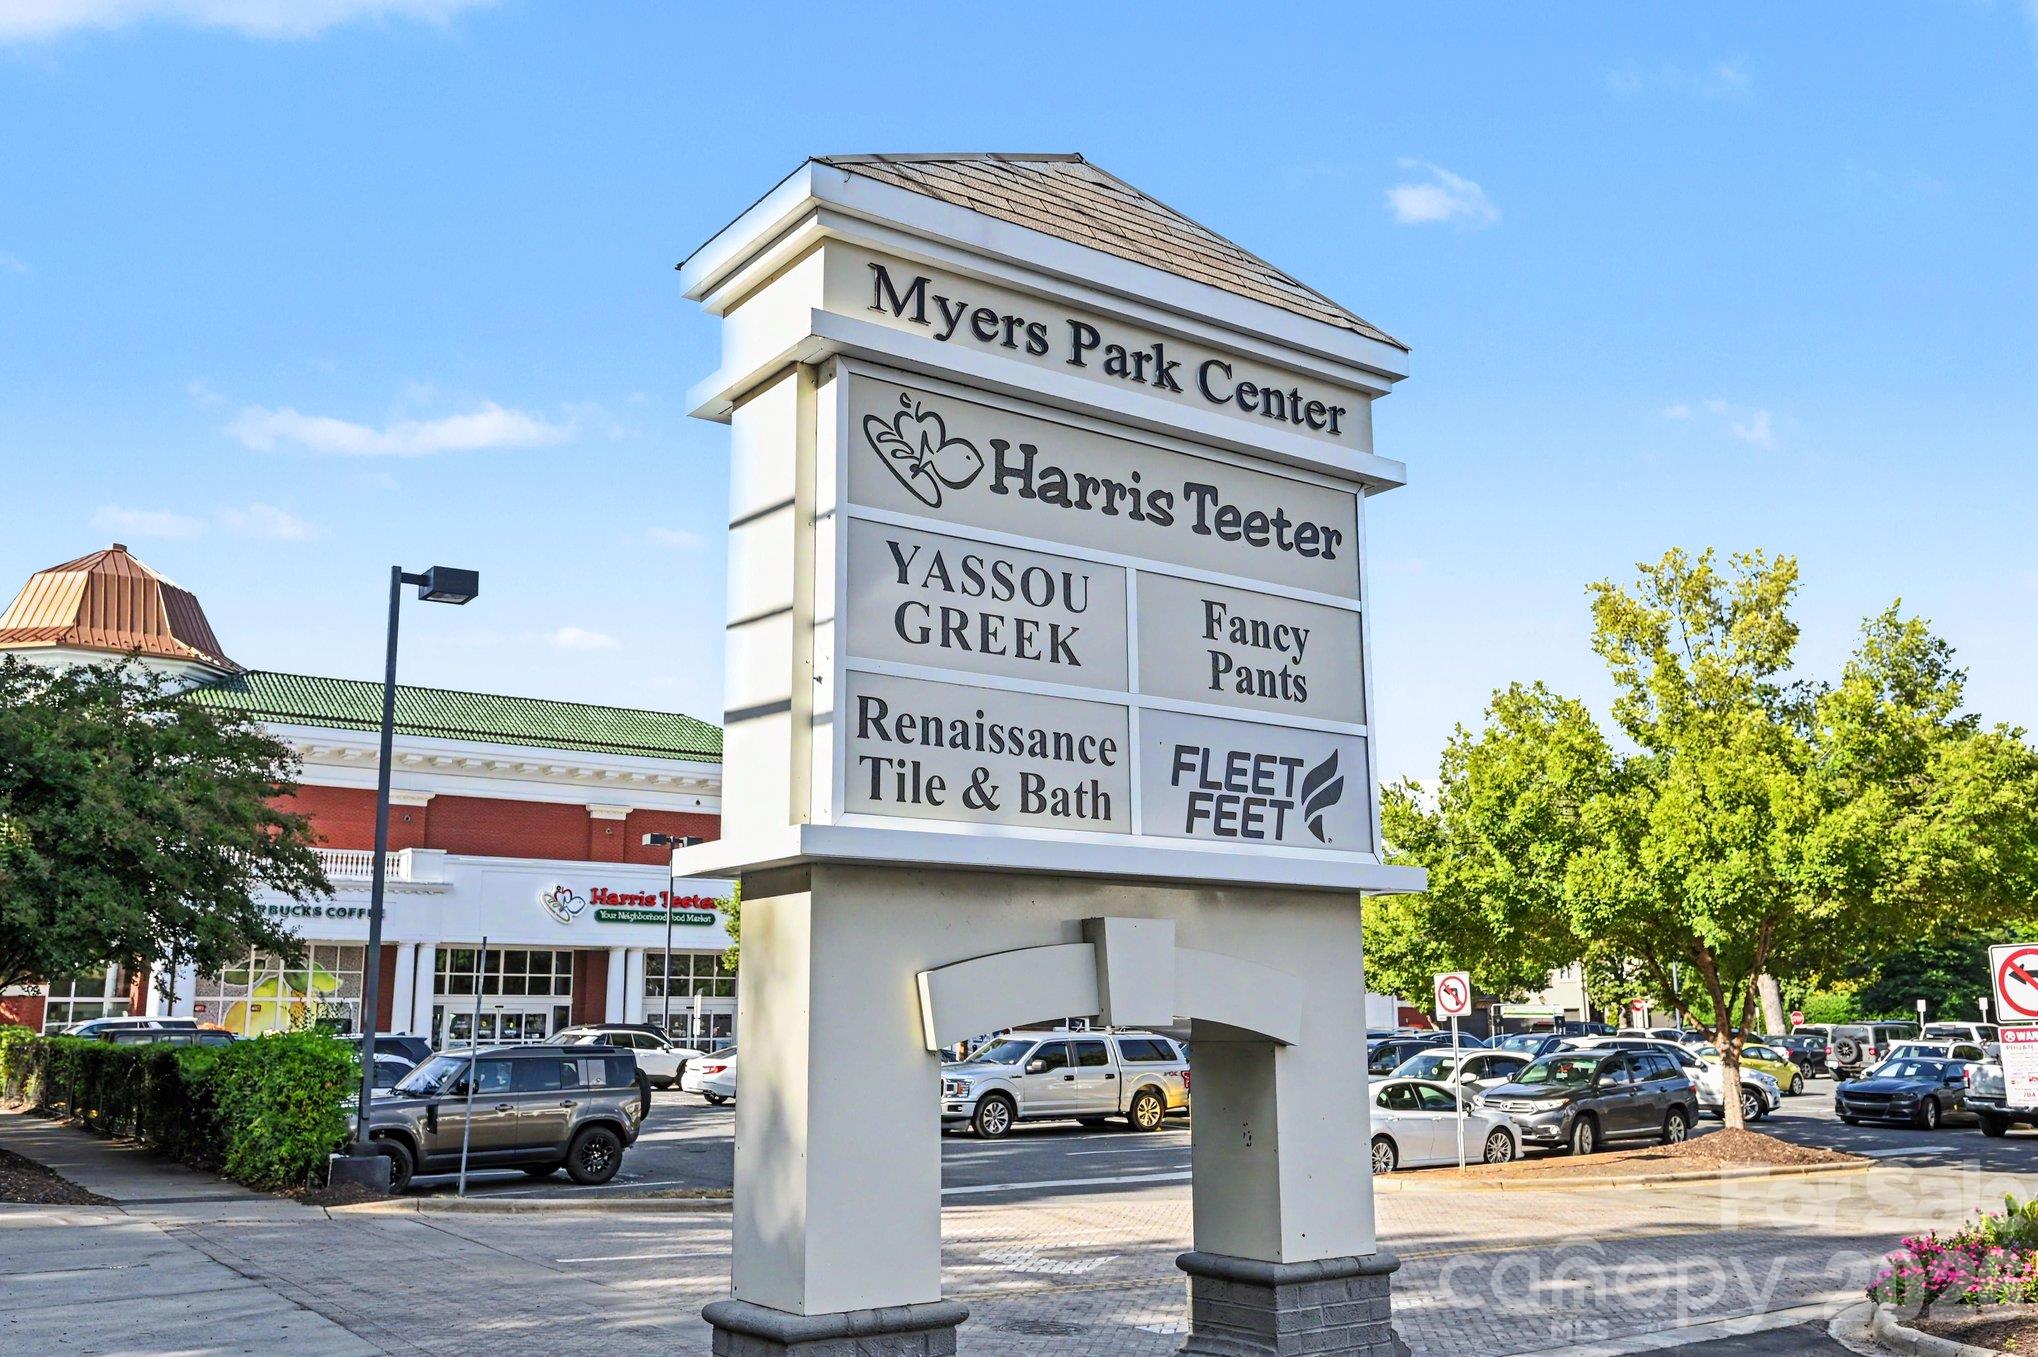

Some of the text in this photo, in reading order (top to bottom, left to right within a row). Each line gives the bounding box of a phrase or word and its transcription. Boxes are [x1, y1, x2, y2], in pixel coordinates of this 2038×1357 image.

[868, 262, 1347, 436] Myers Park Center
[988, 438, 1343, 560] Harris Teeter
[886, 540, 1090, 614] YASSOU
[895, 600, 1082, 667] GREEK
[1201, 599, 1310, 665] Fancy
[1208, 649, 1308, 703] Pants
[856, 695, 1118, 767] Renaissance
[859, 755, 1112, 821] Tile & Bath
[1171, 744, 1304, 797] FLEET
[1185, 791, 1295, 840] FEET
[589, 887, 657, 907] Harris
[600, 910, 617, 919] Your
[618, 912, 667, 922] Neighborhood
[686, 914, 711, 923] Market
